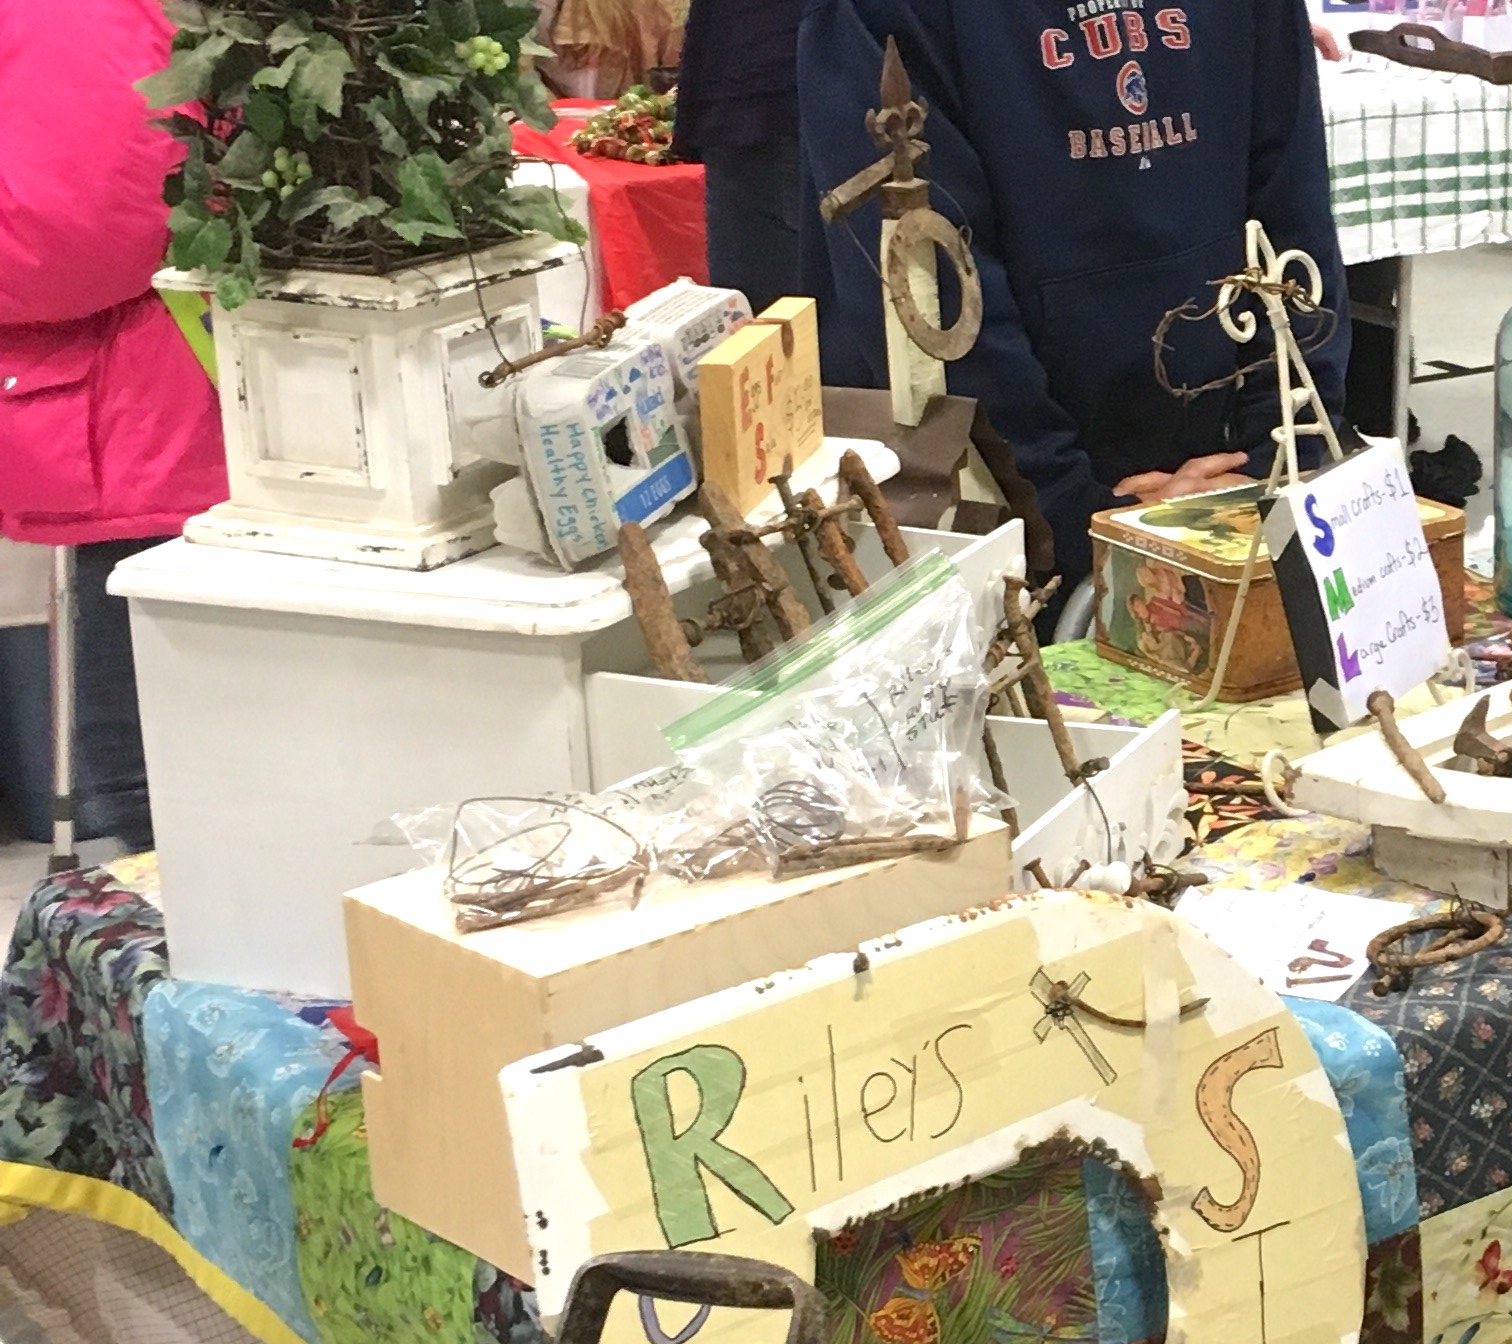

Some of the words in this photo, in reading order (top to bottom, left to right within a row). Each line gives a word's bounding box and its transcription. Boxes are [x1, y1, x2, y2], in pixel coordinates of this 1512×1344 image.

[1040, 8, 1192, 70] CUBS
[539, 423, 570, 499] Healthy
[565, 421, 594, 485] Happy
[1304, 493, 1353, 558] Small
[1323, 566, 1377, 622] Medium
[630, 1023, 973, 1250] Riley's
